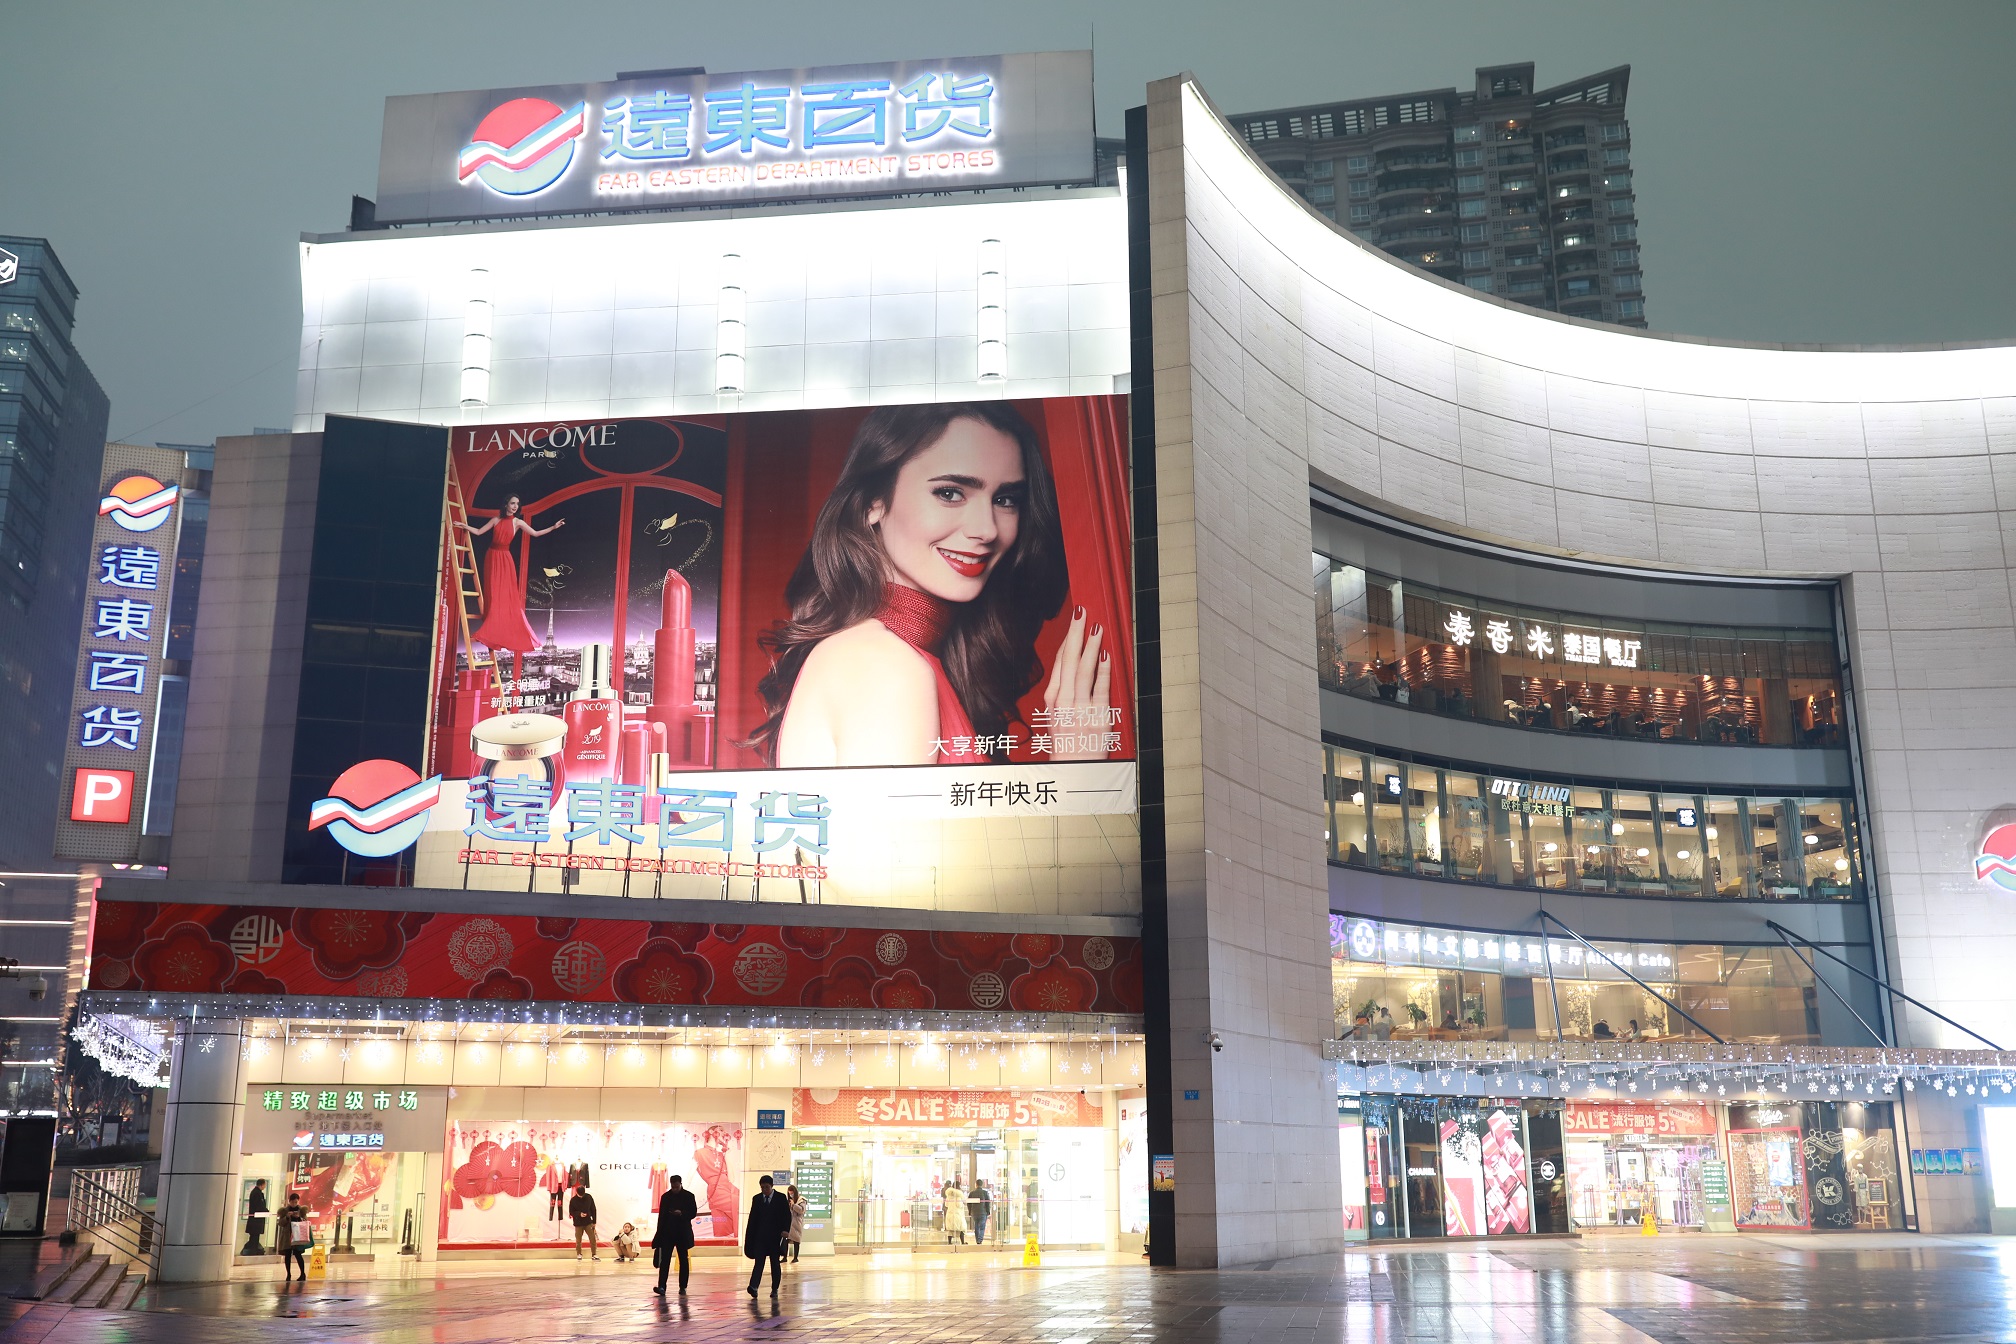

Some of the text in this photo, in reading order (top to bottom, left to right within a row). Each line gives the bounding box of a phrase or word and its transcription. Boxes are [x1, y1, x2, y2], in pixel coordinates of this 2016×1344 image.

[600, 71, 993, 161] 遠東百货
[598, 149, 995, 191] FAR EASTERN DEPARTMENT STORES
[467, 422, 618, 453] LANCÔME
[522, 450, 557, 459] PARS
[81, 545, 160, 751] 遠東百货
[1443, 610, 1555, 660] 泰香米
[572, 702, 615, 714] LANCÔME
[1030, 704, 1122, 729] 兰蔻祝你
[927, 731, 1122, 757] 大享新年 美丽如愿
[83, 774, 123, 817] P
[950, 780, 1059, 807] 新年快乐
[1490, 778, 1571, 803] OTTO LINA
[463, 773, 832, 856] 遠東百货
[457, 848, 829, 880] FAR EASTERN DEPARTMENT STORES
[1638, 952, 1671, 968] Cafe
[263, 1090, 418, 1111] 精致超级市场
[856, 1096, 945, 1123] 冬SALE
[949, 1102, 1010, 1120] 流行服饰
[303, 1111, 374, 1121] Supermarket
[1566, 1111, 1610, 1130] SALE
[1612, 1114, 1656, 1129] 流行服饰
[599, 1162, 650, 1171] CIRCLE
[1408, 1167, 1437, 1176] CHANEL
